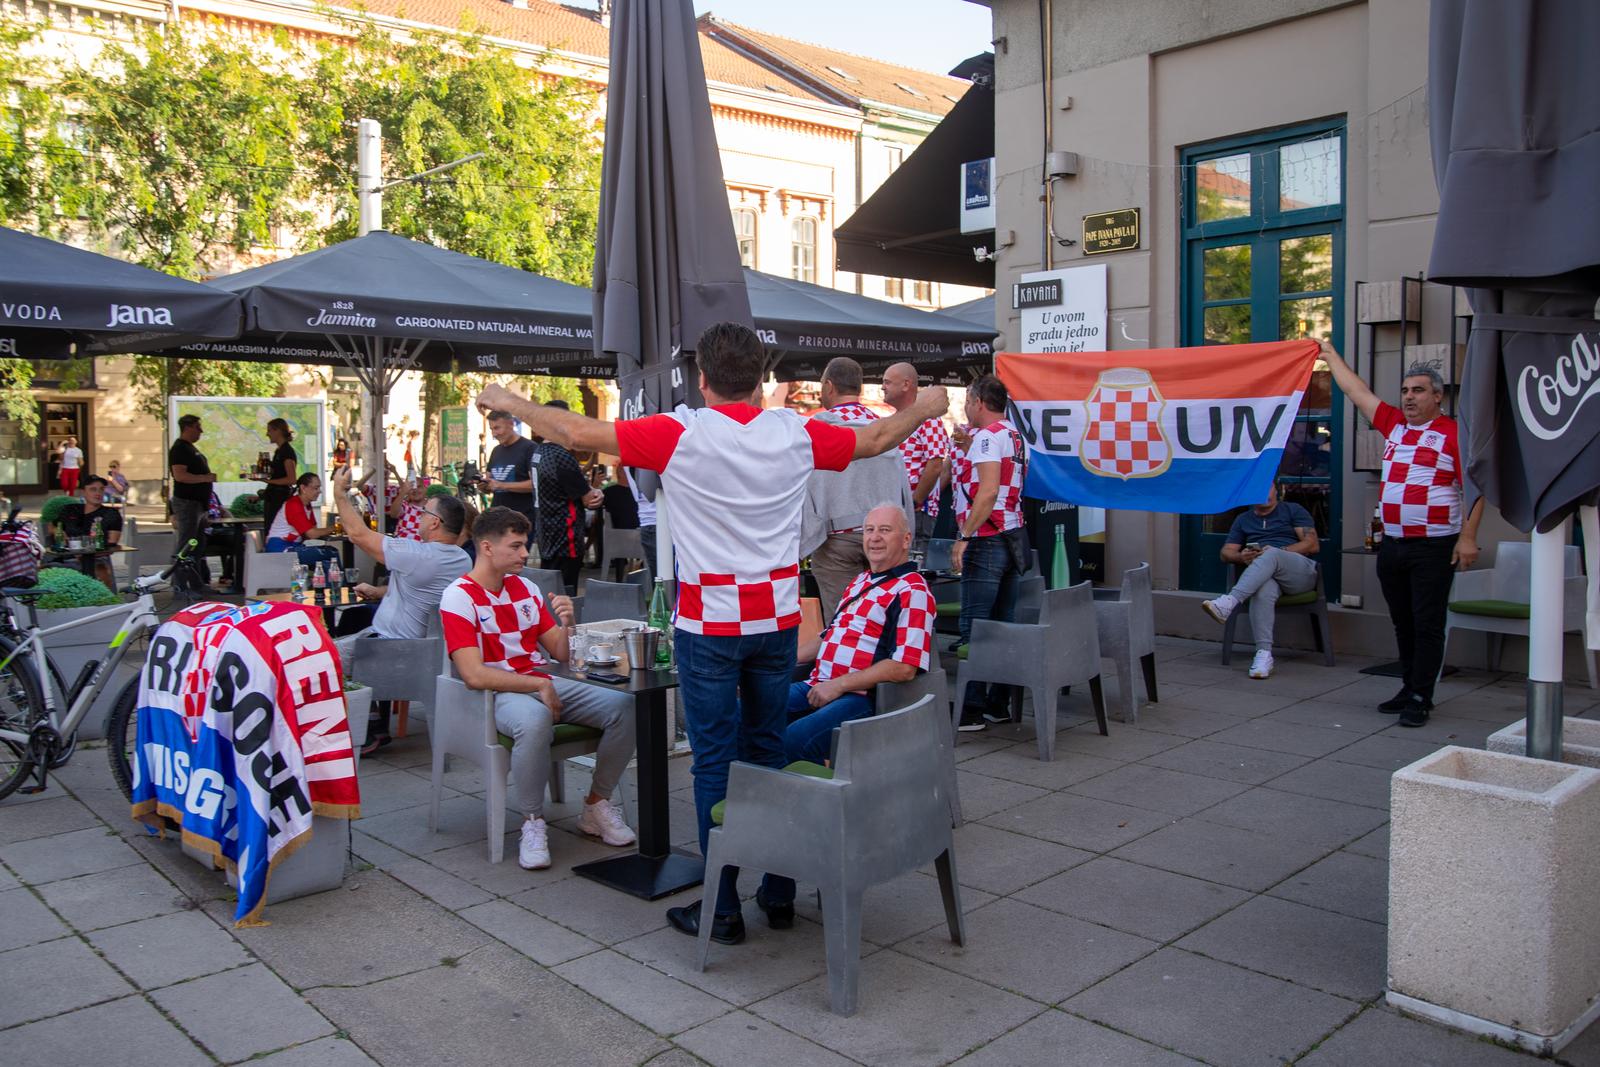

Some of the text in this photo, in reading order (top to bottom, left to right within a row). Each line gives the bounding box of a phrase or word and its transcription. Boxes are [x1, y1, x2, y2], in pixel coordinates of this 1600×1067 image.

[1020, 285, 1057, 303] KAVANA
[2, 303, 62, 321] VODA
[332, 301, 354, 310] 1828
[306, 309, 377, 328] Jamnica
[395, 316, 594, 338] CARBONATED NATURAL MINERAL WA
[1042, 312, 1085, 325] U ovom
[1028, 324, 1099, 345] gradu jedno
[798, 335, 942, 353] PRIRODNA MINERALNA VODA
